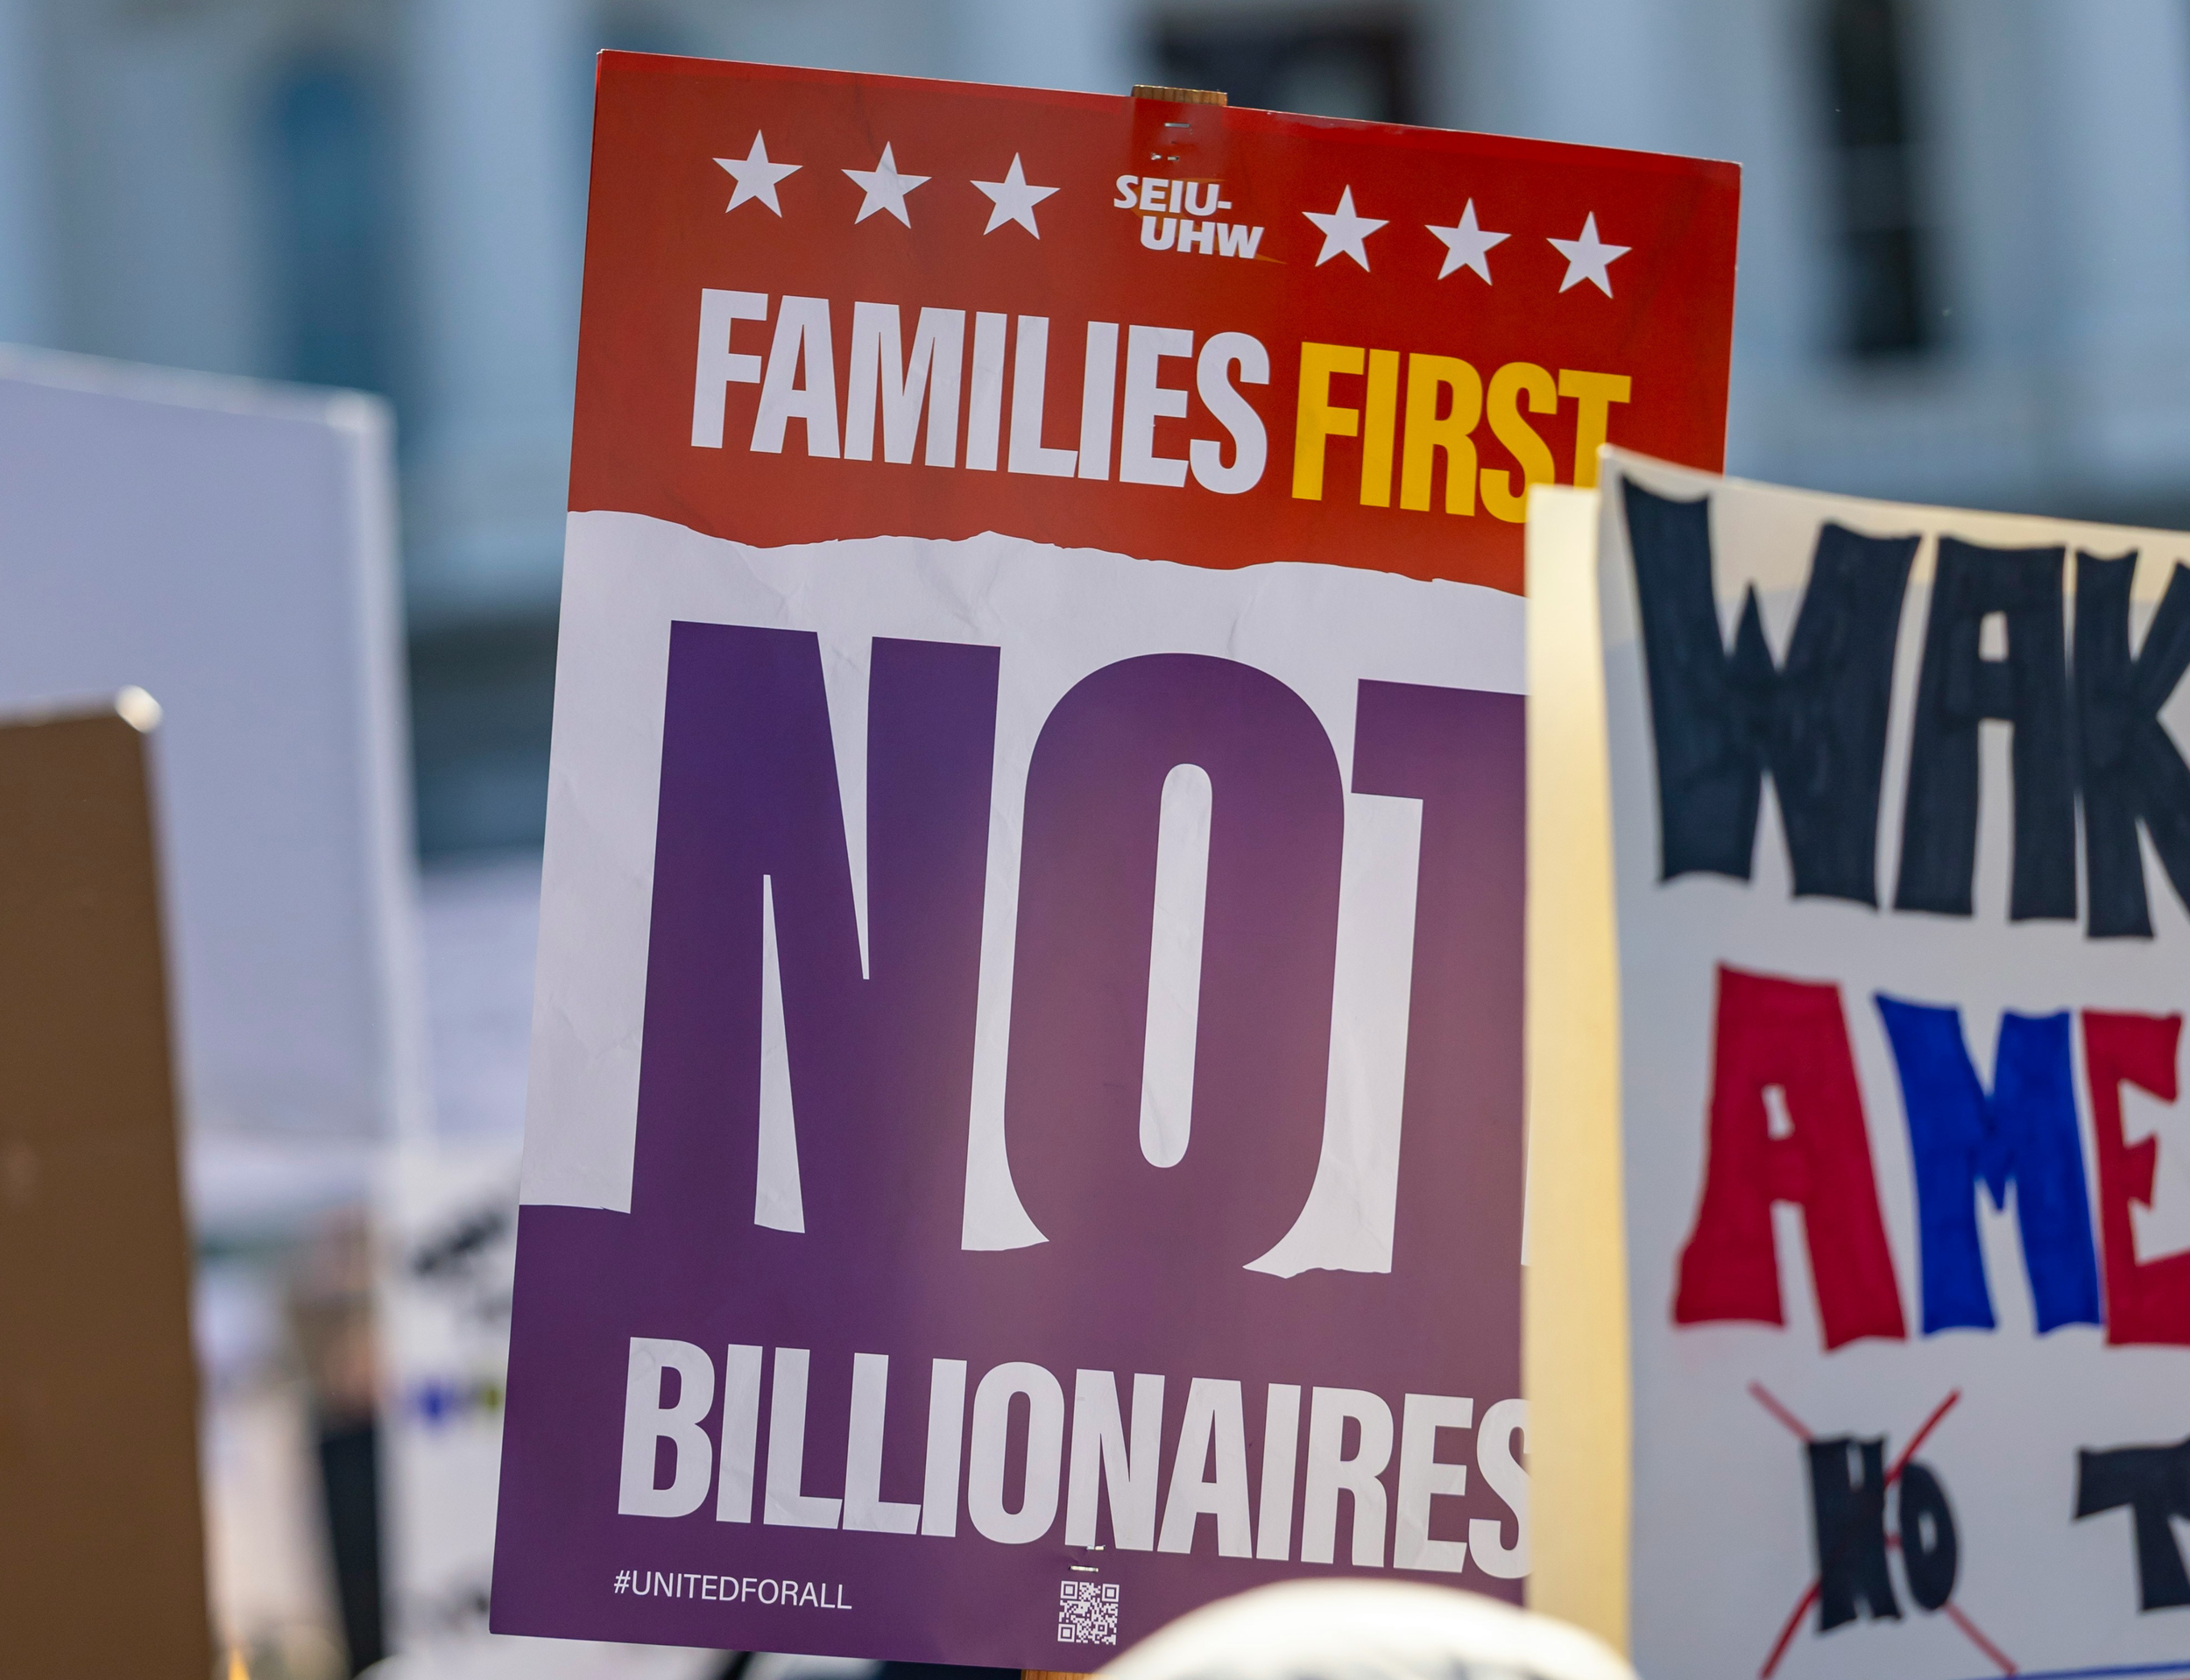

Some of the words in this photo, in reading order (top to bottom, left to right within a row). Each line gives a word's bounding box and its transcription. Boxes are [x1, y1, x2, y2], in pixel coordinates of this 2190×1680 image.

[1113, 173, 1233, 216] SEIU-
[1140, 215, 1264, 259] UHW
[690, 287, 1270, 496] FAMILIES
[1291, 341, 1632, 524] FIRST
[1620, 471, 2190, 941] WAK
[629, 620, 1529, 1278] NOT
[1671, 961, 2190, 1353] AME
[618, 1337, 1532, 1578] BILLIONAIRES
[613, 1570, 852, 1610] #UNITEDFORALL
